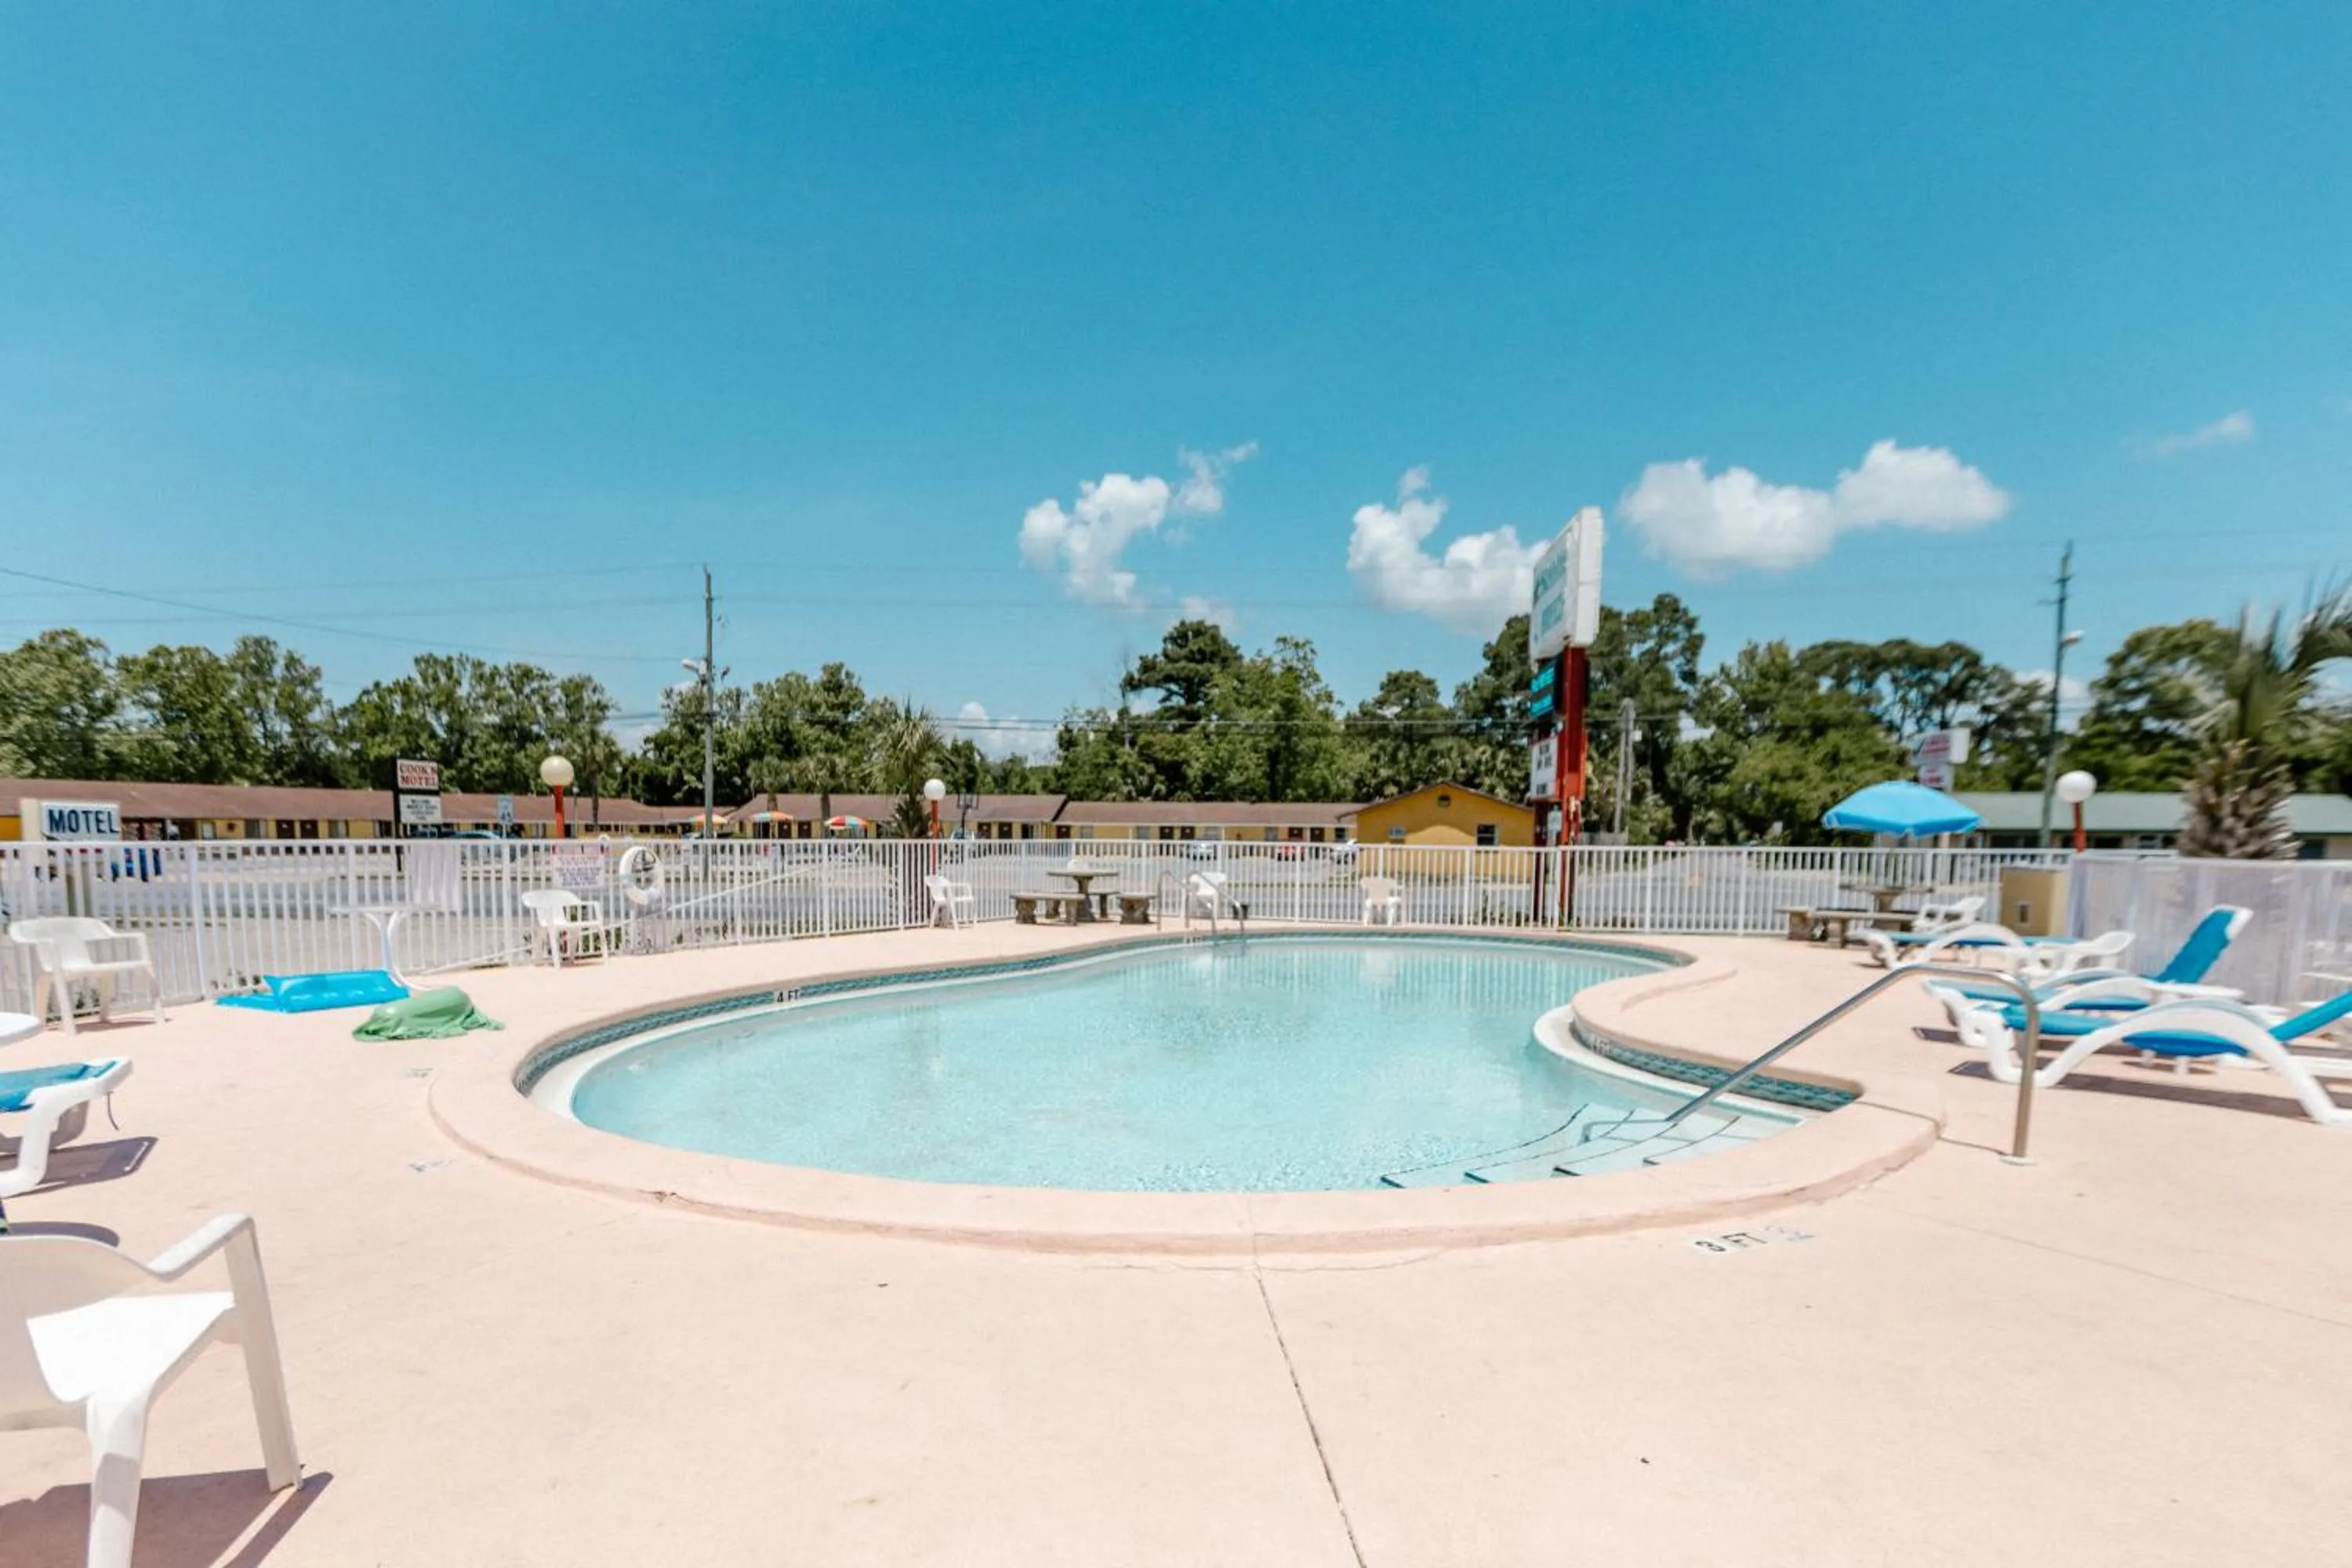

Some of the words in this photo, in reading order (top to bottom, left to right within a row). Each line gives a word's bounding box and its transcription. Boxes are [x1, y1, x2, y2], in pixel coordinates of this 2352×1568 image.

[401, 775, 436, 786] MOTEL
[48, 808, 119, 833] MOTEL
[777, 990, 783, 1003] 4
[788, 989, 799, 1001] FT
[1721, 1232, 1768, 1248] FT
